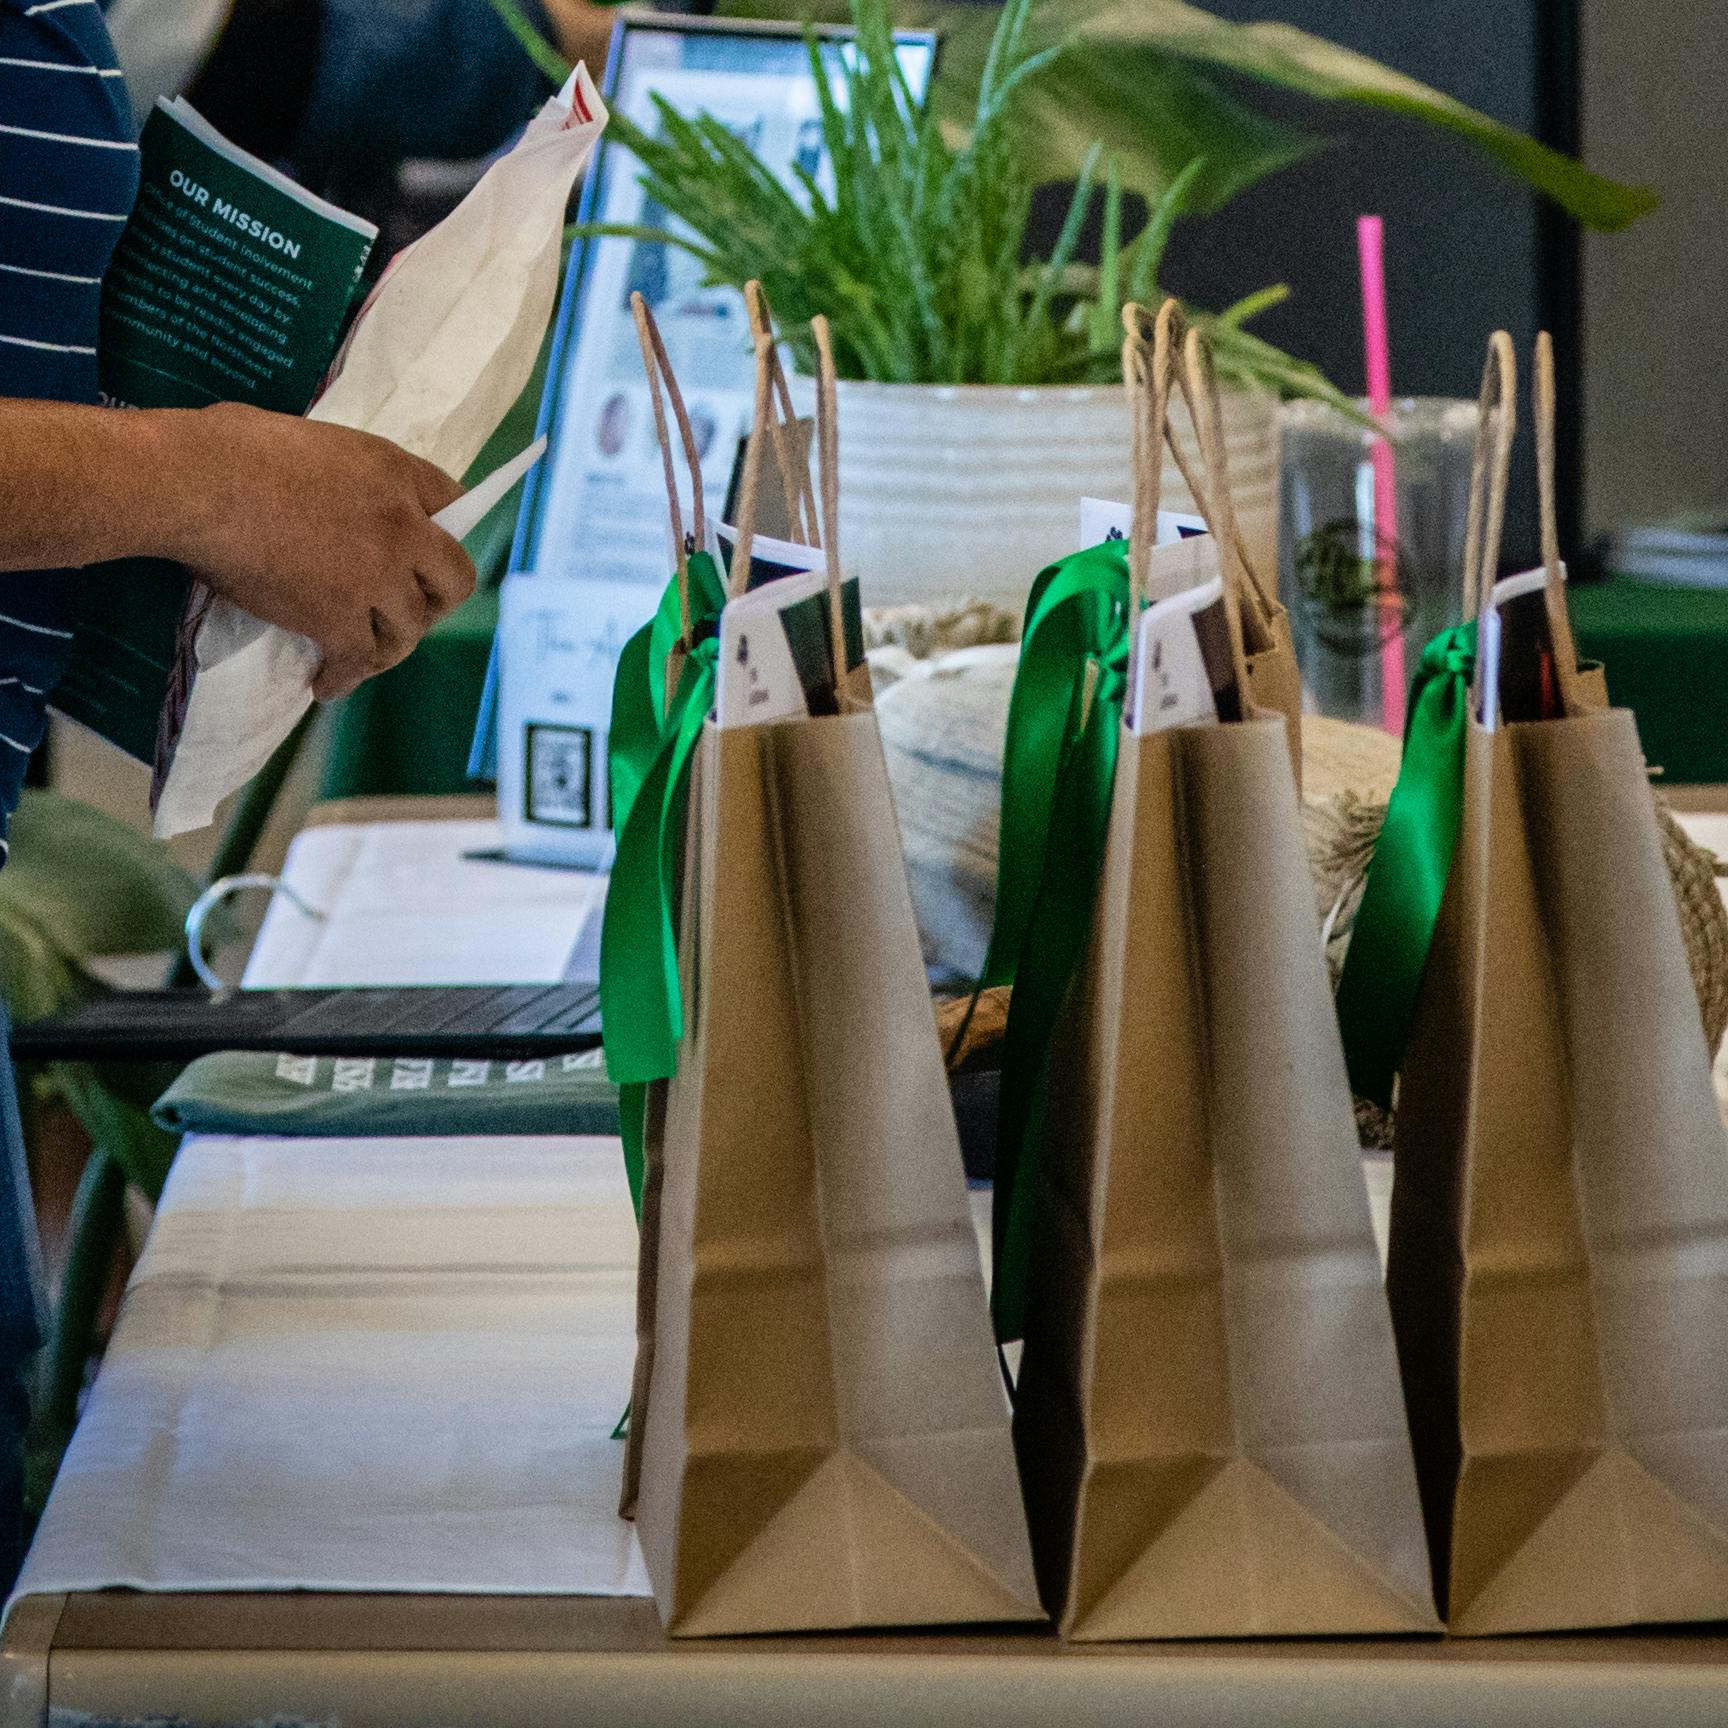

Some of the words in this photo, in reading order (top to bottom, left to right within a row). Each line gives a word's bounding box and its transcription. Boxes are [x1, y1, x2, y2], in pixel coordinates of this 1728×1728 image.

[168, 169, 211, 207] OUR
[212, 197, 302, 260] MISSION
[174, 206, 189, 219] of
[188, 213, 238, 250] Student
[178, 234, 196, 248] on
[197, 244, 247, 277] student
[160, 245, 211, 278] student
[212, 274, 247, 299] every
[248, 293, 272, 314] day
[191, 284, 218, 302] and
